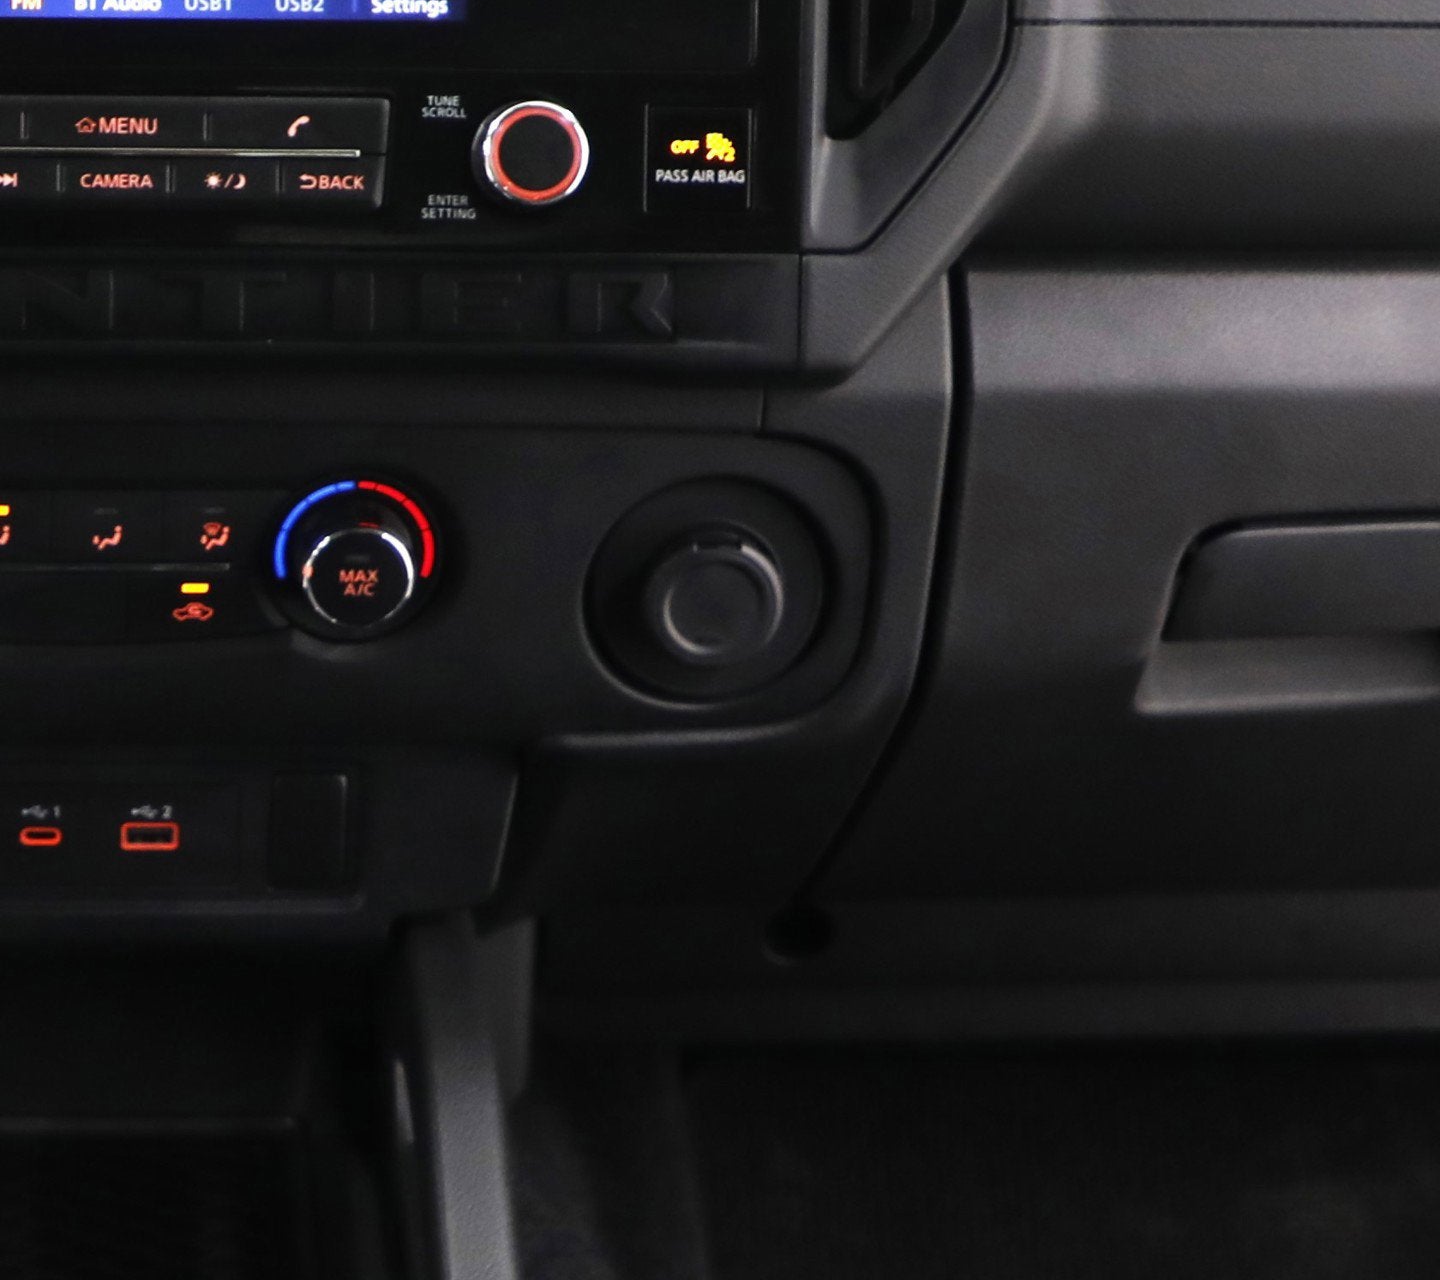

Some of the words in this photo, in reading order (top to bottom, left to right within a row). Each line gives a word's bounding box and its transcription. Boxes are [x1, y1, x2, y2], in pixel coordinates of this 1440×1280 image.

[427, 95, 460, 107] TUNE
[422, 107, 467, 118] SCROLL
[99, 117, 158, 134] MENU
[670, 139, 700, 154] OFF
[80, 172, 153, 190] CAMERA
[319, 174, 364, 191] BACK
[655, 169, 689, 182] PASS
[691, 169, 715, 182] AIR
[717, 169, 746, 183] BAG
[427, 194, 468, 206] ENTER
[421, 207, 477, 219] SETTING
[339, 569, 378, 582] MAX
[344, 583, 375, 596] A/C
